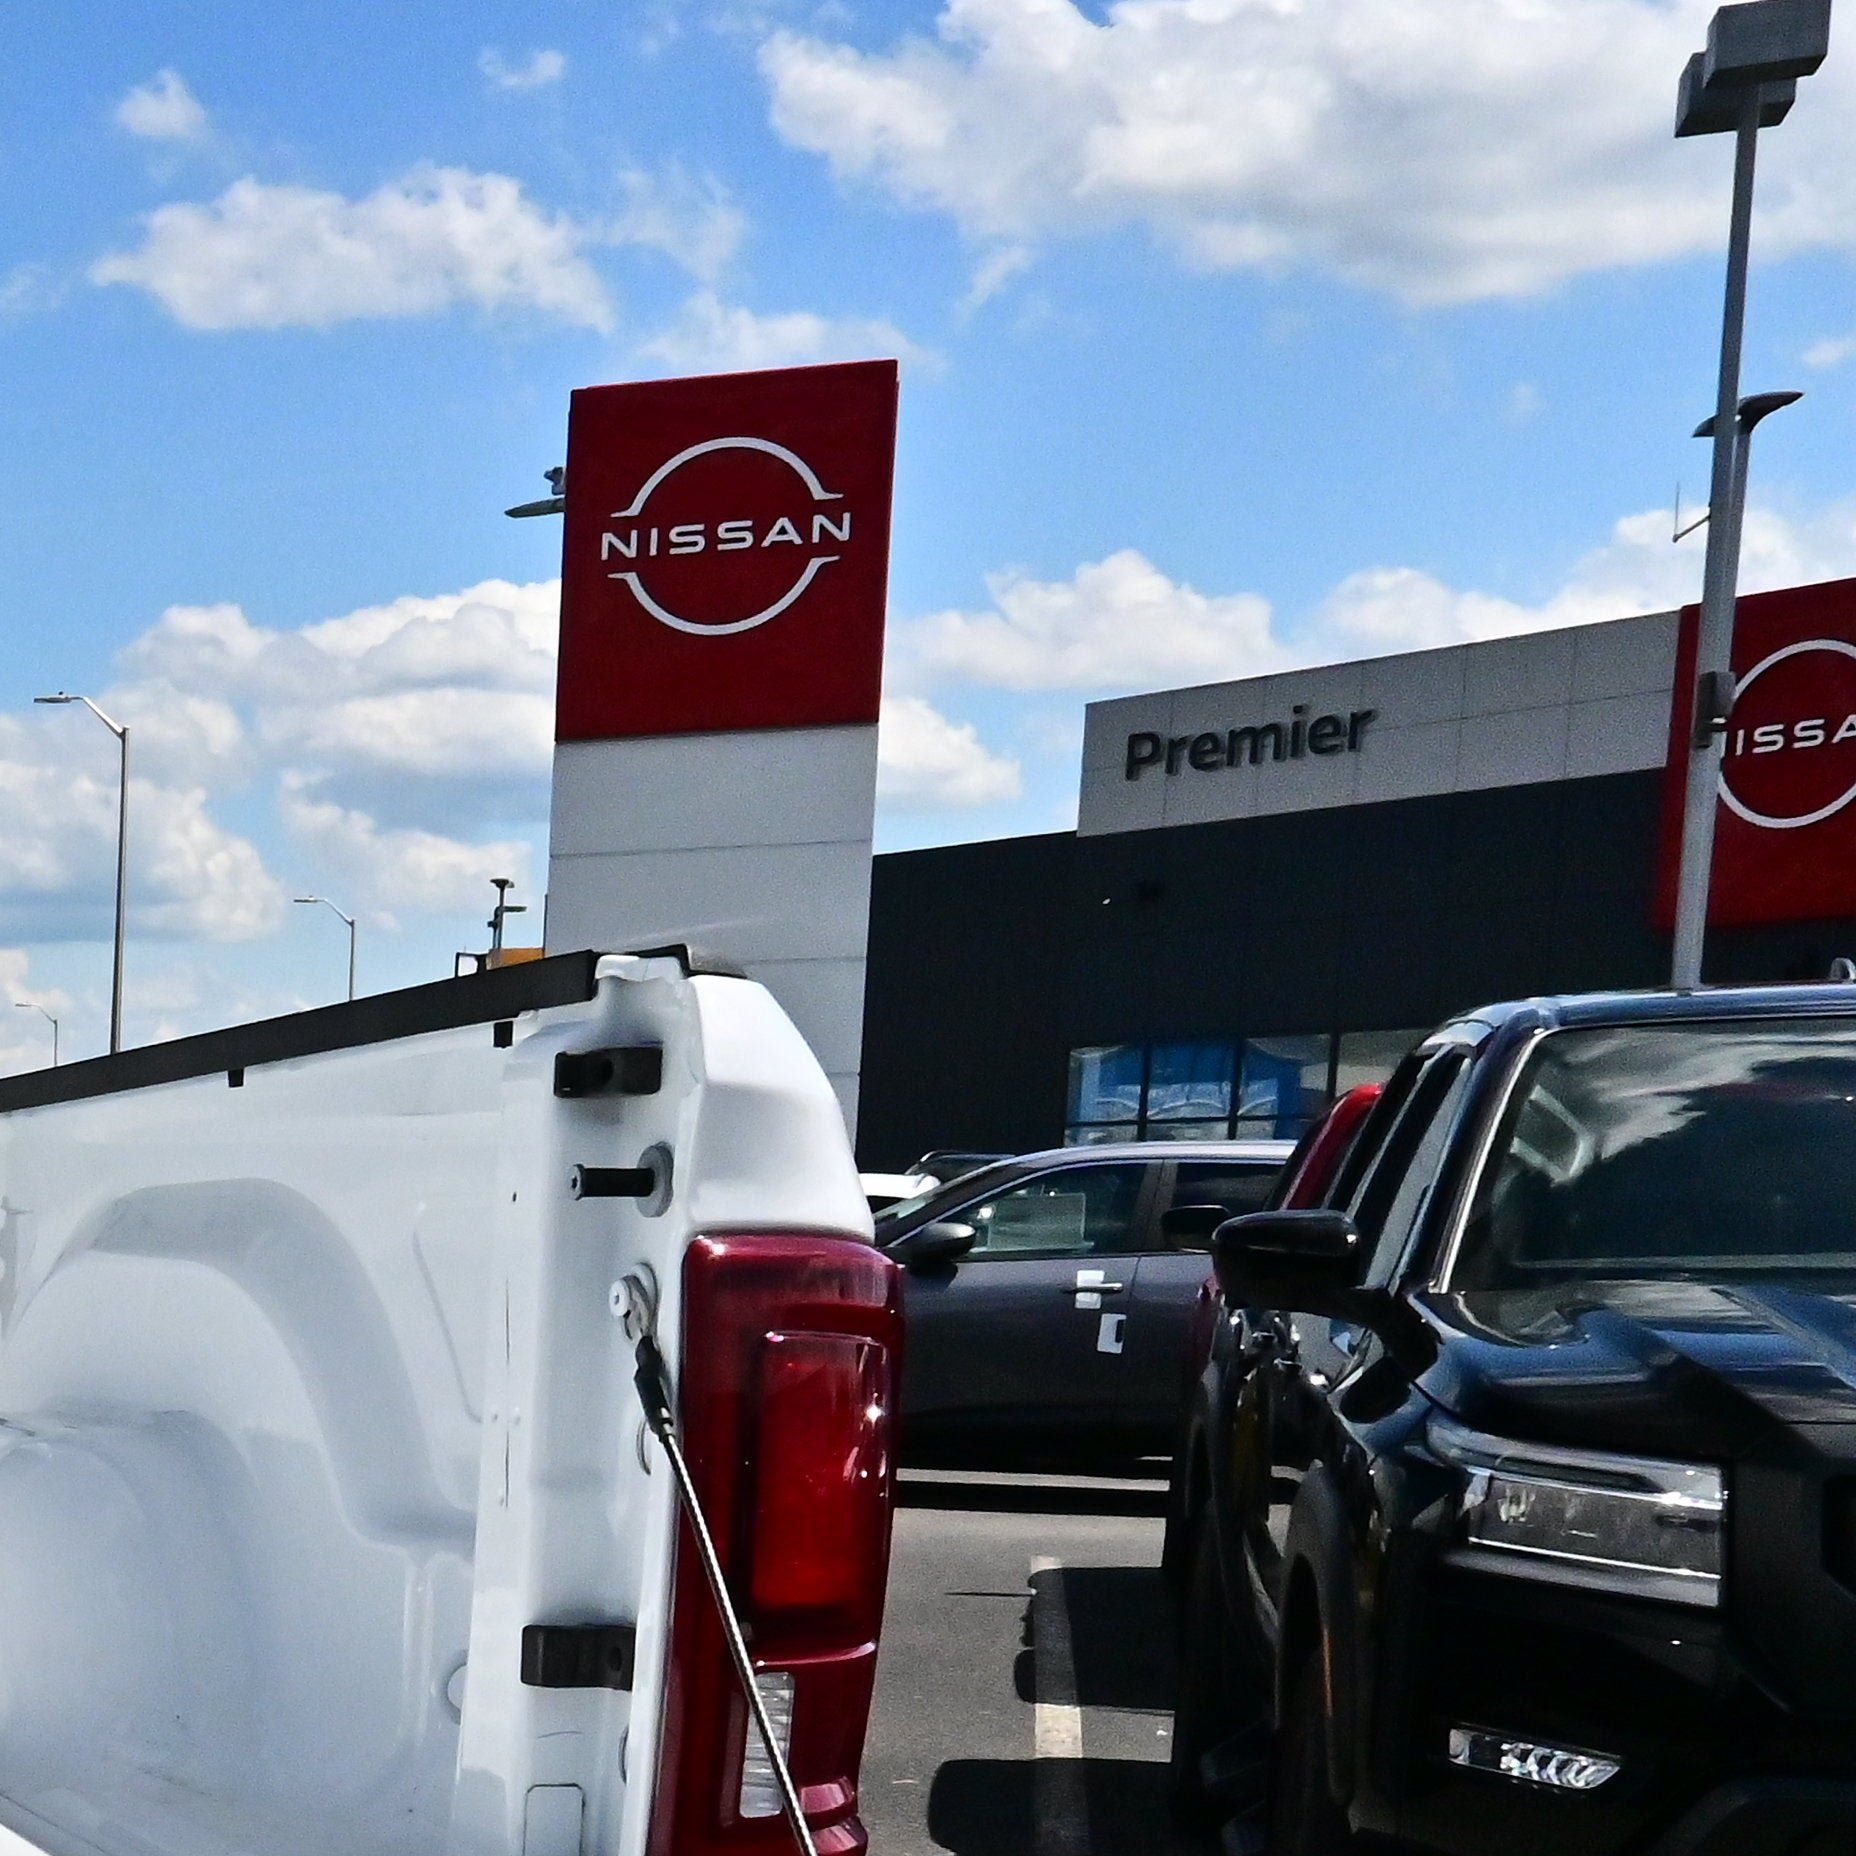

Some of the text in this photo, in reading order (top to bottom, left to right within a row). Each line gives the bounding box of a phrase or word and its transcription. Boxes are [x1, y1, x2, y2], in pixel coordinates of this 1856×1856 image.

[601, 512, 851, 561] NISSAN
[1125, 703, 1378, 781] Premier
[1721, 713, 1856, 757] ISSA
